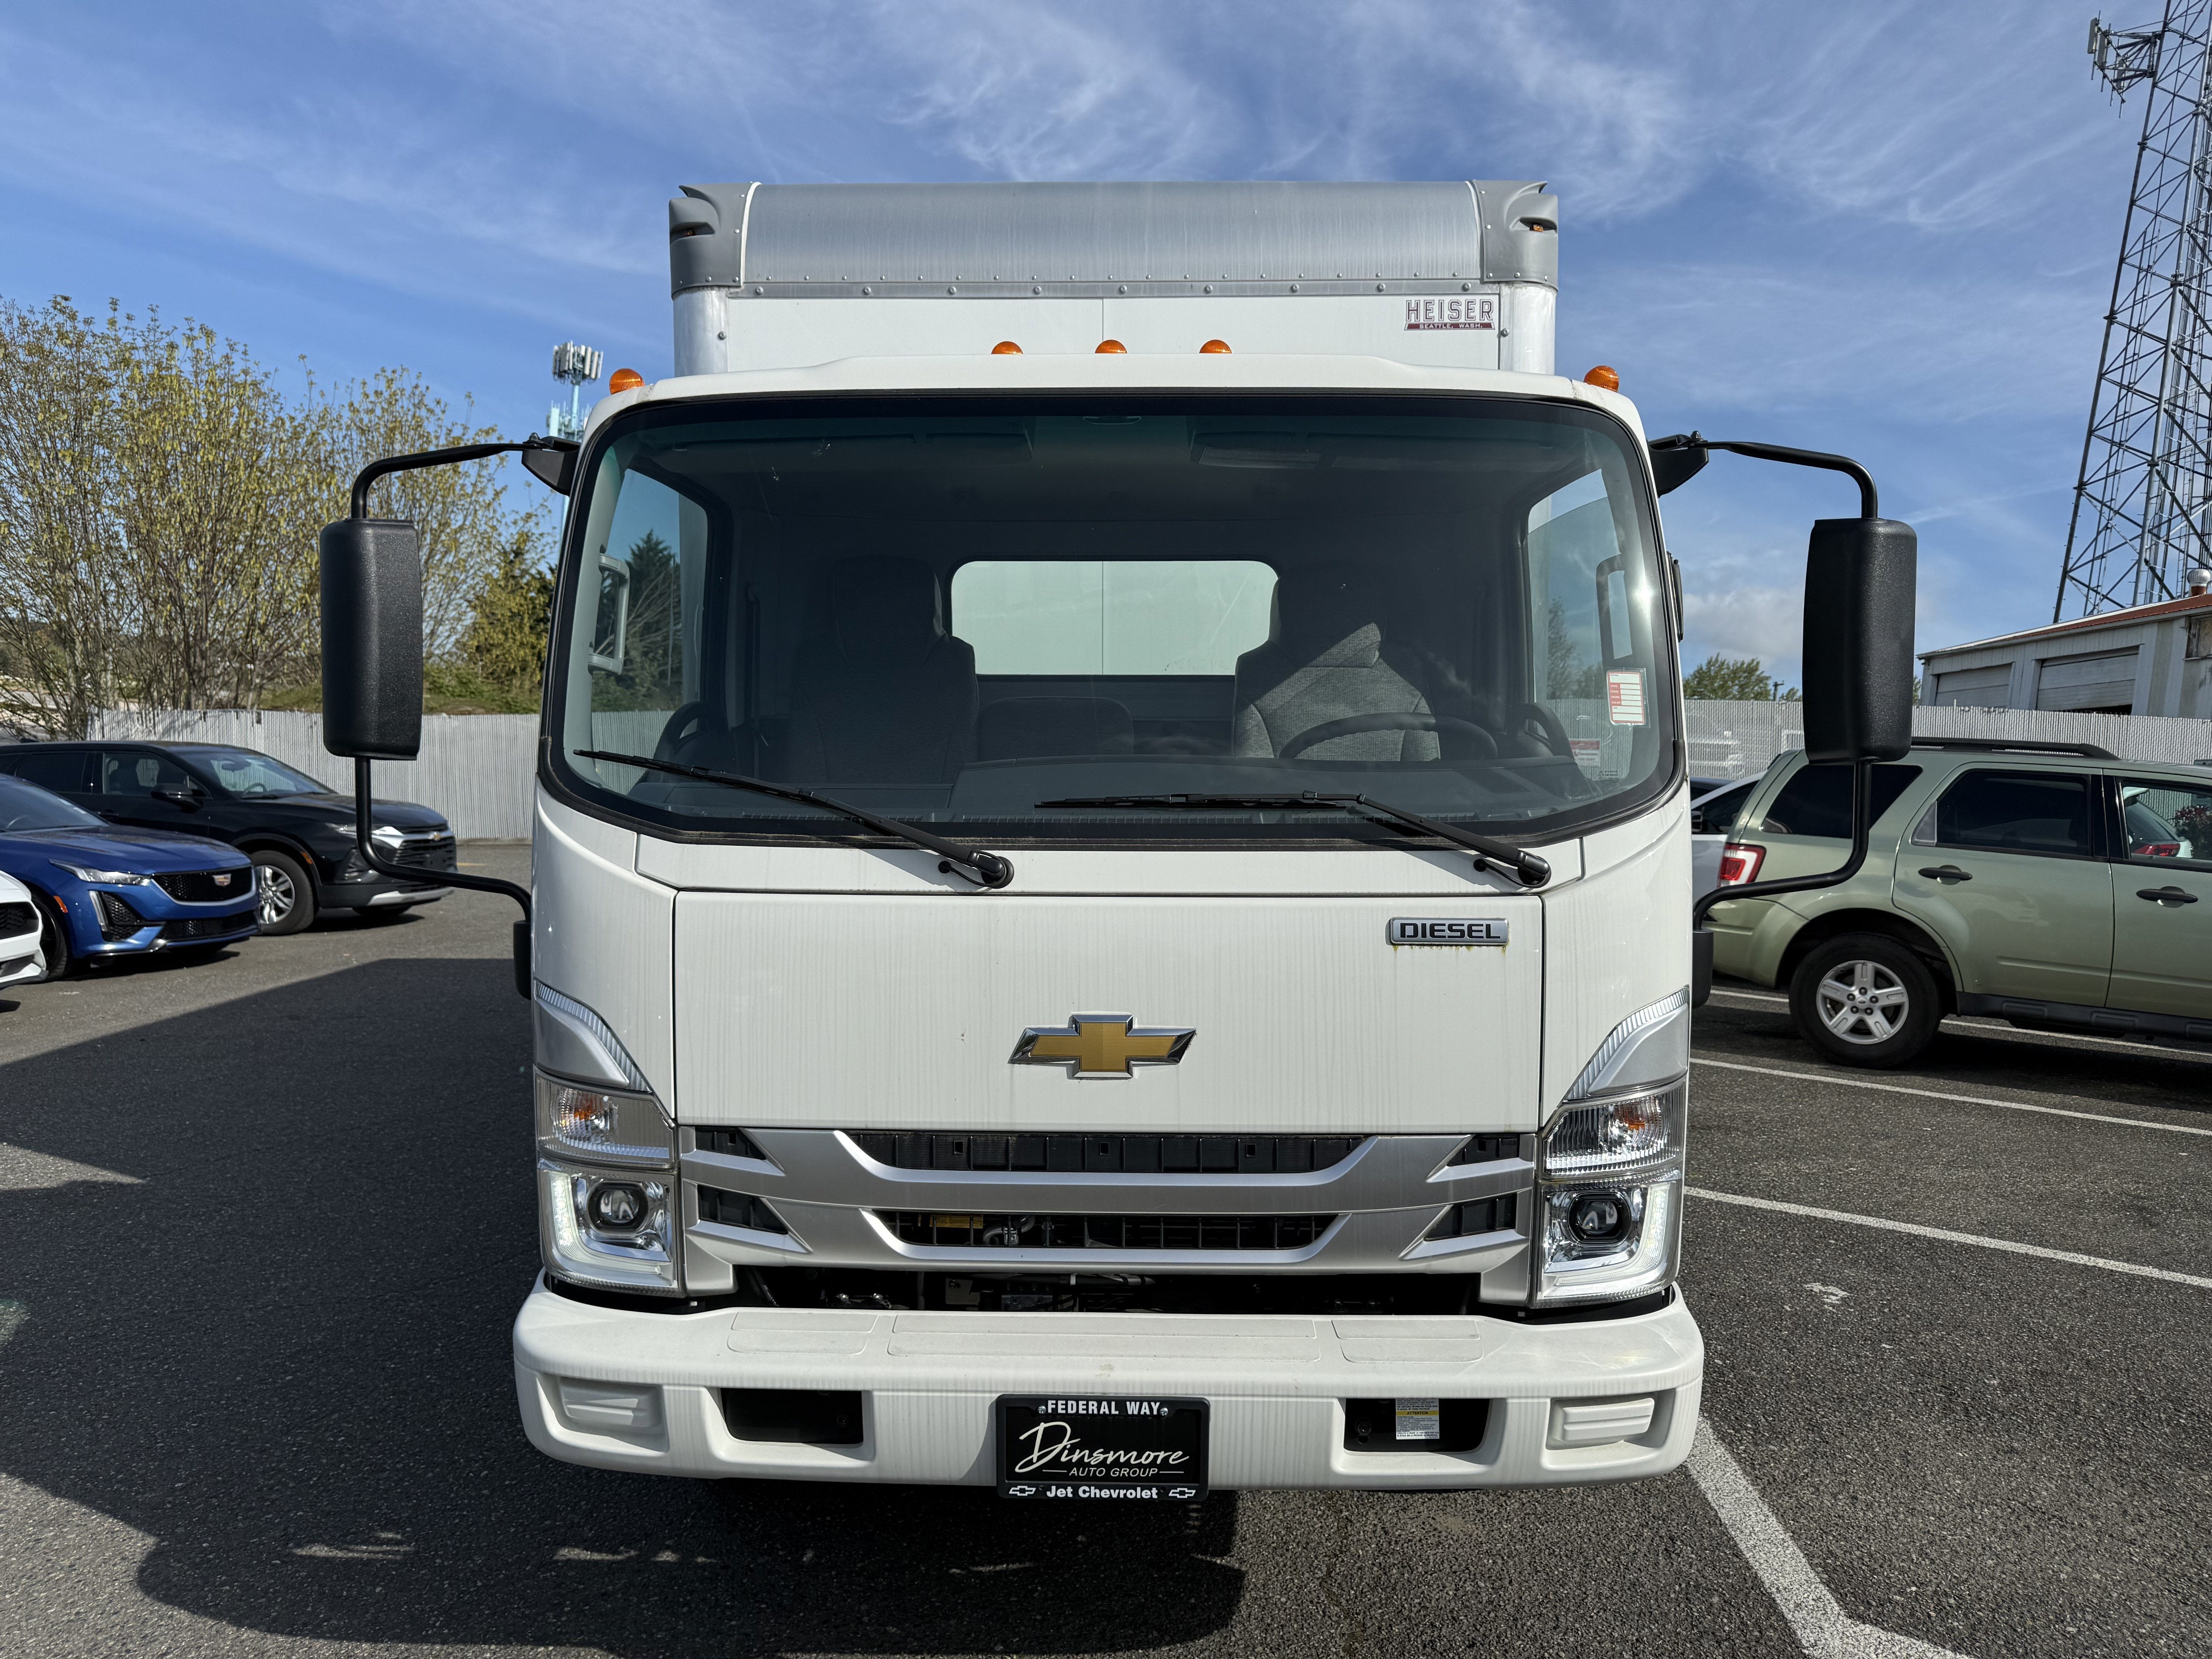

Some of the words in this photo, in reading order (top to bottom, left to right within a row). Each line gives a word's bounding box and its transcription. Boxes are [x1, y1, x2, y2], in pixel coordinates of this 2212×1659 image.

[1406, 299, 1494, 322] HEISER
[1400, 922, 1501, 939] DIESEL
[1047, 1400, 1119, 1415] FEDERAL
[1126, 1401, 1160, 1415] WAY
[1014, 1421, 1190, 1473] Dinsmore
[1068, 1467, 1106, 1477] AUTO
[1110, 1467, 1158, 1477] GROUP
[1046, 1486, 1073, 1498] Jet
[1078, 1486, 1158, 1499] Chevrolet
